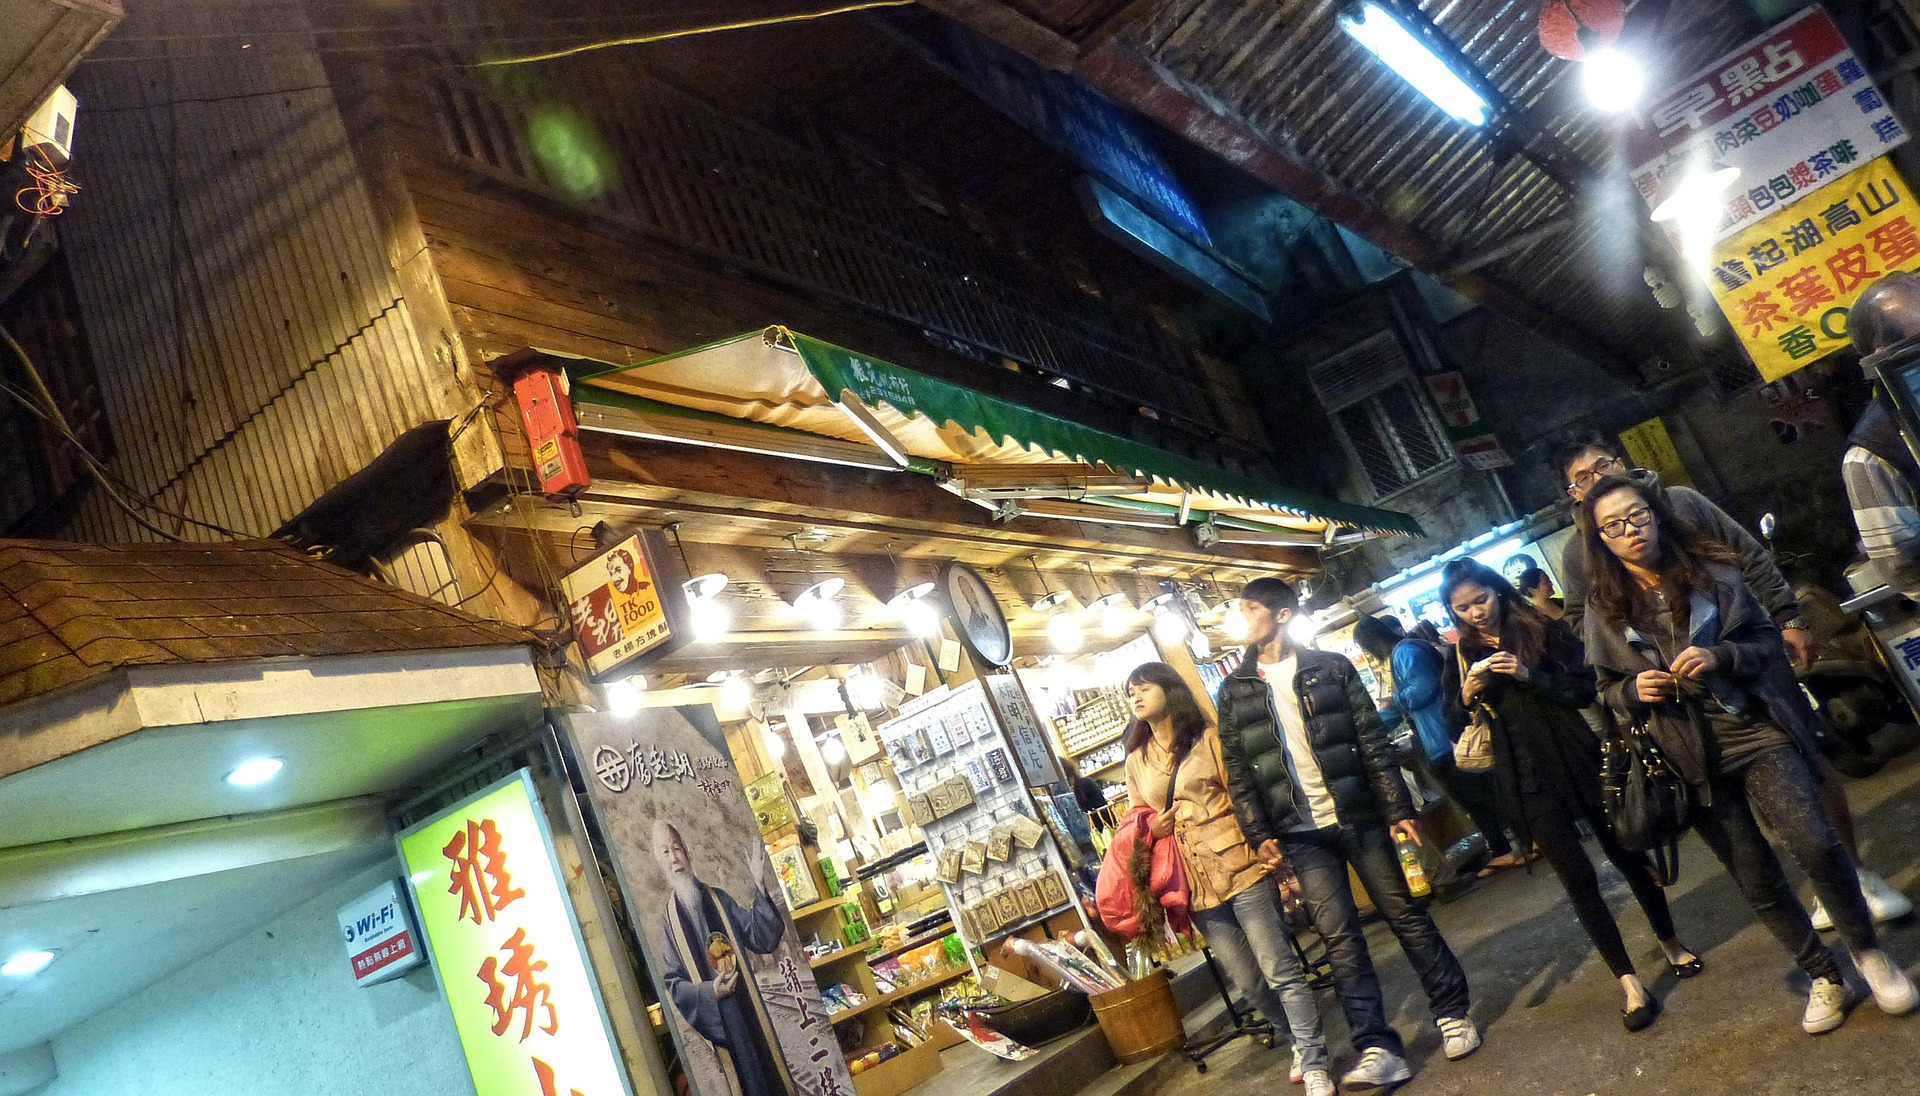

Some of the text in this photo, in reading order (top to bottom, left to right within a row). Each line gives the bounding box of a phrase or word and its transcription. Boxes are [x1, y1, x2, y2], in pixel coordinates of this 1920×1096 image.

[1652, 39, 1804, 138] 早點
[1712, 179, 1900, 292] 奮起湖高山
[1739, 215, 1920, 338] 茶葉皮蛋
[620, 598, 639, 614] TK
[623, 600, 655, 626] FOOD
[356, 903, 394, 936] Wi-Fi
